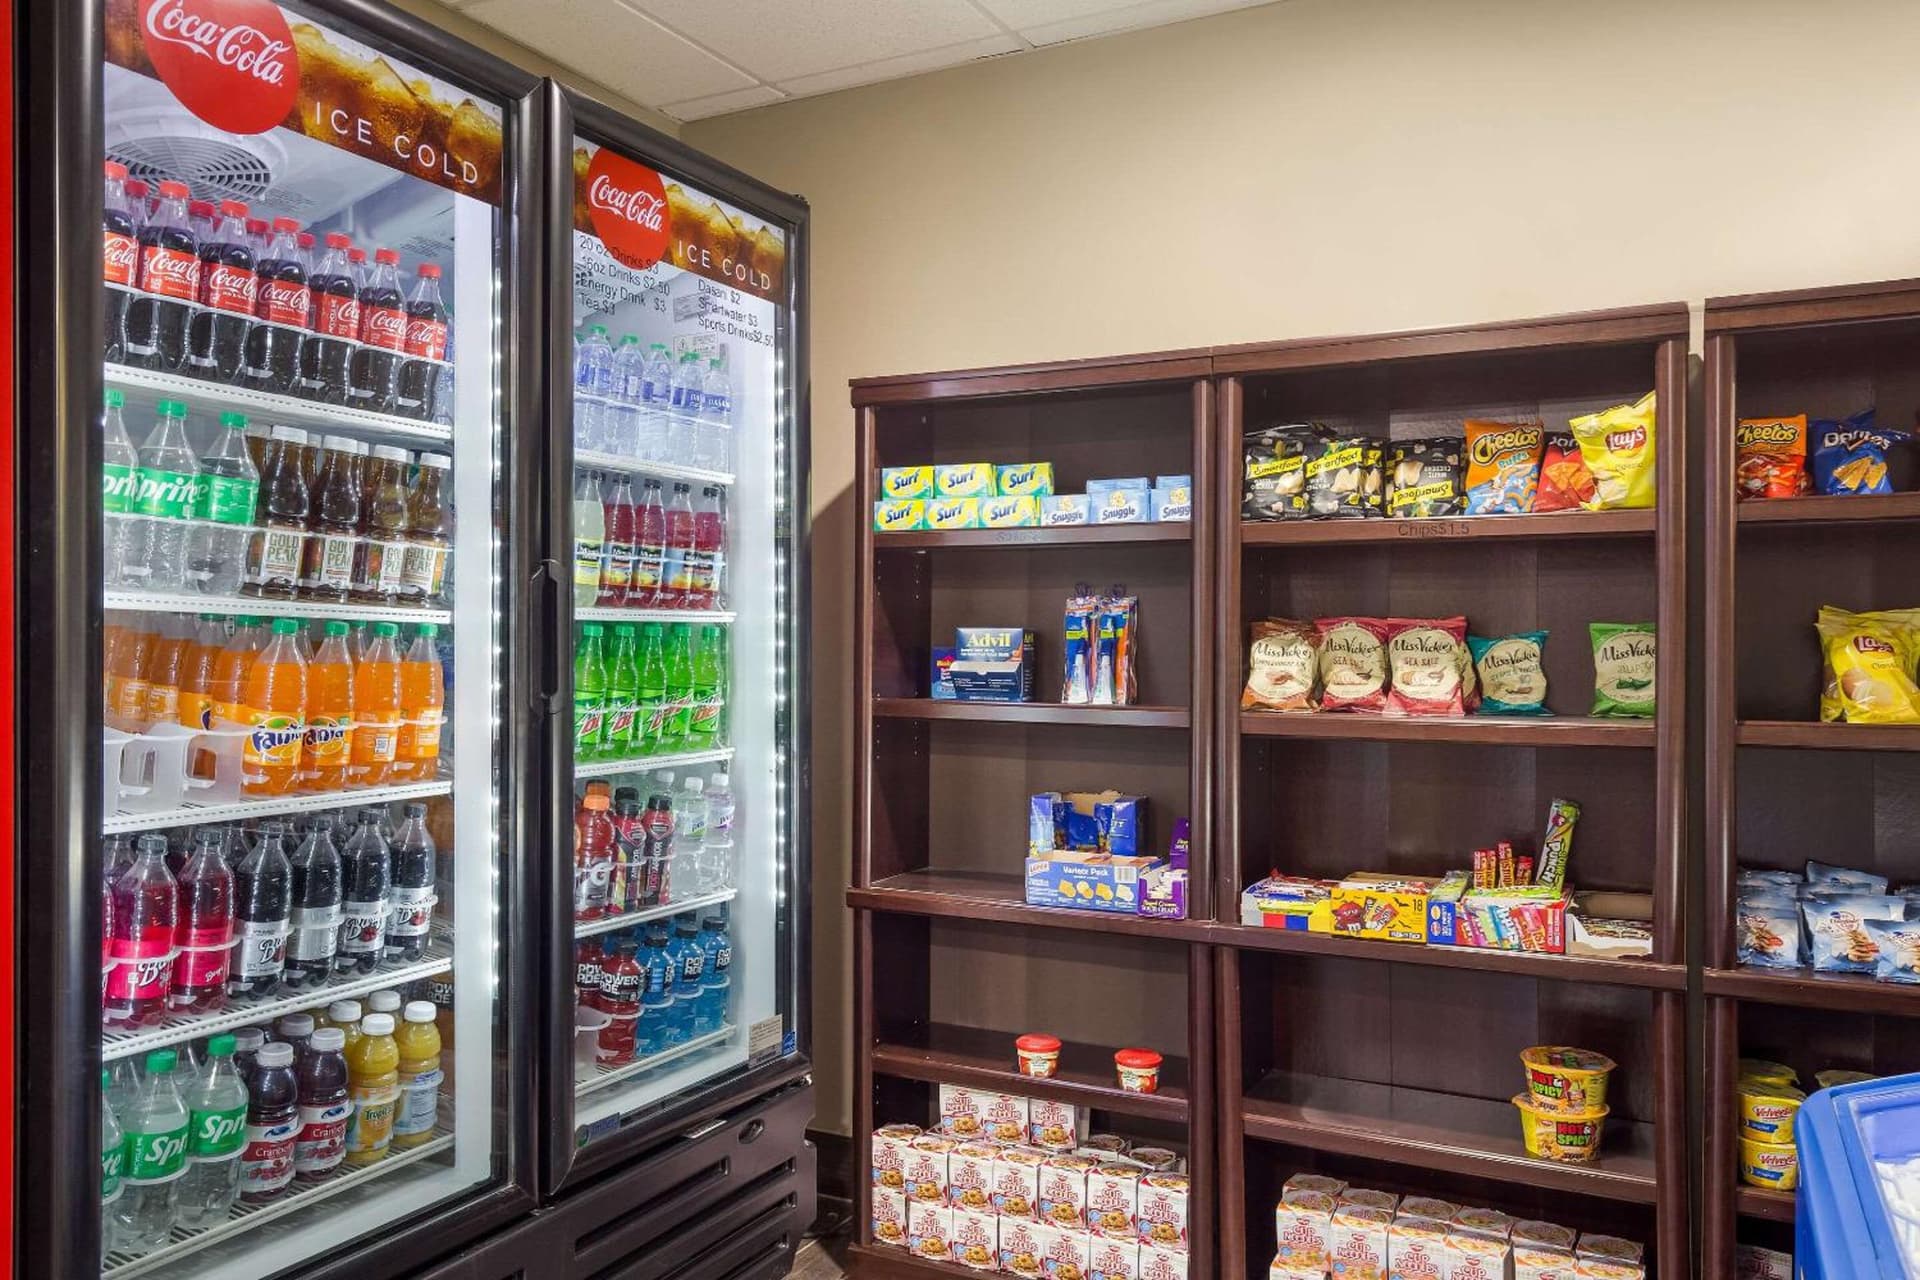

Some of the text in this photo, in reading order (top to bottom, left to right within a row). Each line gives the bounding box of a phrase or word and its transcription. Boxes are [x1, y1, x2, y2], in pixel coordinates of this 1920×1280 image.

[146, 0, 293, 86] Coca-Cola
[314, 101, 479, 185] ICE COLD
[590, 175, 667, 232] Coca-Cola
[678, 240, 772, 290] ICE COLD
[580, 278, 617, 300] Energy
[654, 297, 667, 313] $3
[730, 290, 741, 305] $2
[748, 313, 758, 328] $3
[1609, 427, 1646, 451] Lay's
[1737, 424, 1797, 444] Cheetos
[1824, 430, 1891, 450] Doritos
[1473, 427, 1539, 464] Cheetos
[1309, 450, 1359, 473] Smartfood
[894, 469, 920, 491] Surf
[948, 469, 975, 488] Surf
[1009, 466, 1037, 488] Surf
[1397, 481, 1449, 500] Smartfood
[886, 502, 912, 524] Surf
[937, 502, 963, 522] Surf
[991, 501, 1018, 521] Surf
[1051, 512, 1083, 524] Snuggle
[1102, 506, 1136, 520] Snuggle
[269, 532, 300, 547] GOLD
[267, 547, 298, 561] PEAK
[965, 632, 1011, 647] Advil
[1394, 637, 1418, 652] Miss
[1255, 642, 1282, 658] Miss
[1601, 647, 1630, 664] Miss
[1484, 656, 1510, 672] Miss
[1063, 866, 1109, 876] Variety Pack
[1542, 841, 1561, 883] PUNCH
[1413, 898, 1423, 912] 18
[1532, 1071, 1563, 1088] HOT &
[1533, 1083, 1563, 1099] SPICY
[1558, 1122, 1592, 1134] HOT &
[1558, 1135, 1591, 1145] SPICY
